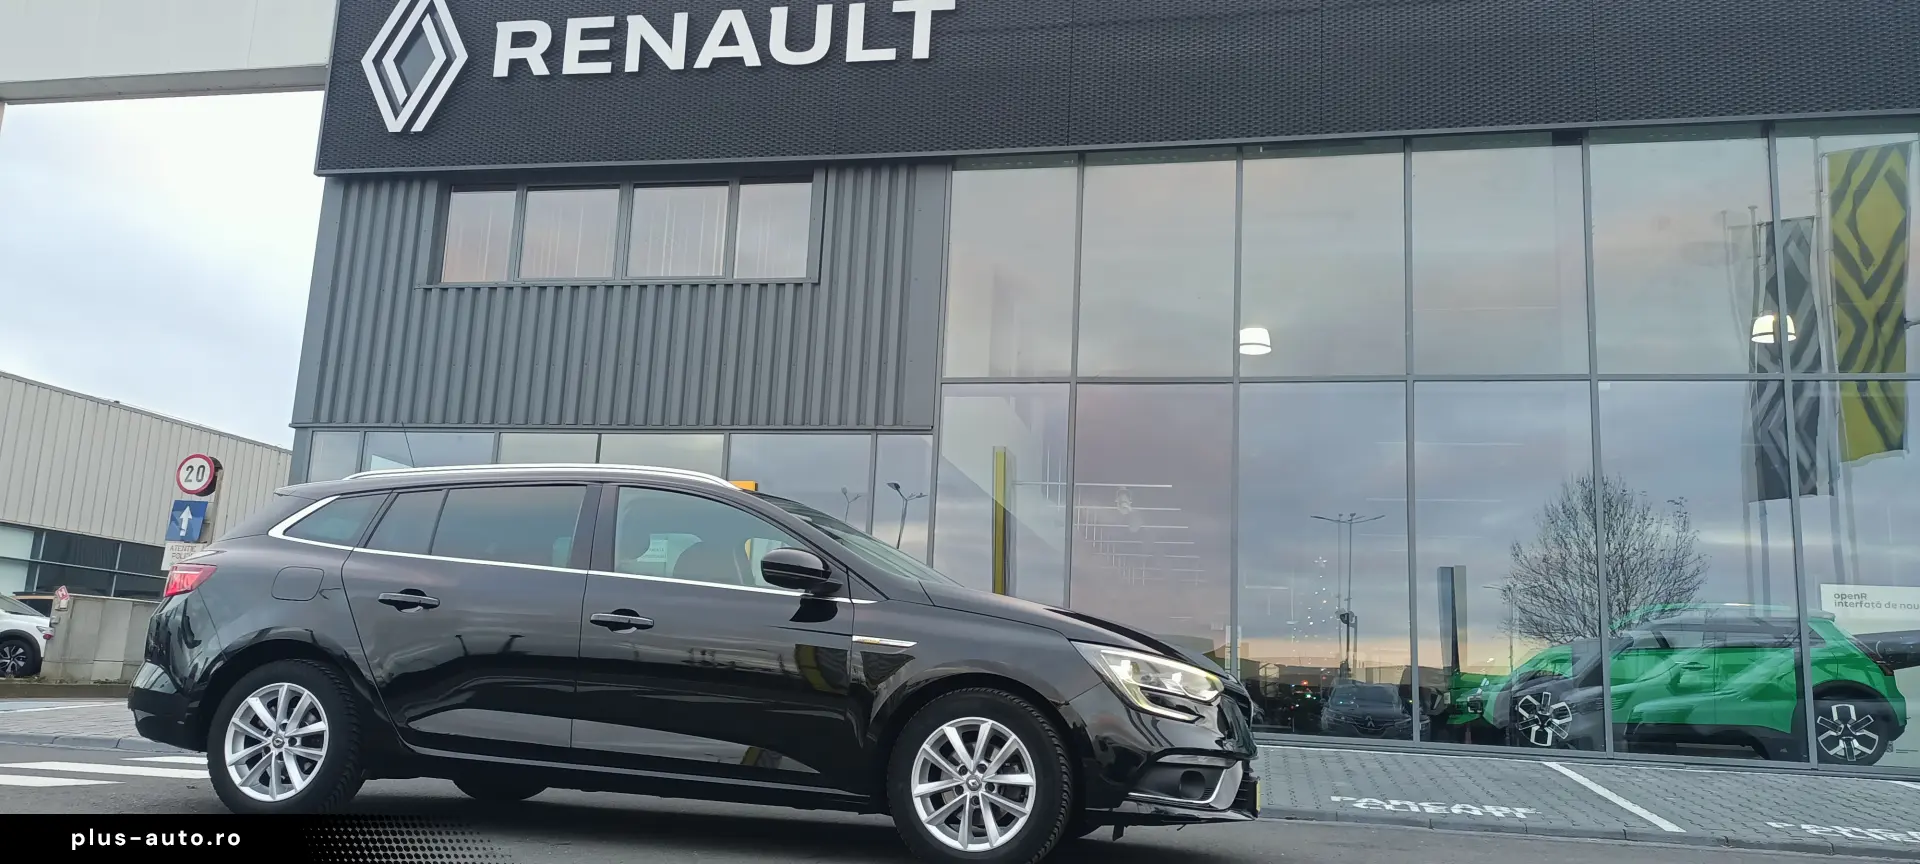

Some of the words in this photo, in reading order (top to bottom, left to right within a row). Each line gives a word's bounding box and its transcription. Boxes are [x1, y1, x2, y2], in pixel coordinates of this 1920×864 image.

[493, 0, 956, 77] RENAULT
[184, 464, 206, 483] 20
[1833, 592, 1867, 601] openR
[1884, 601, 1898, 609] de
